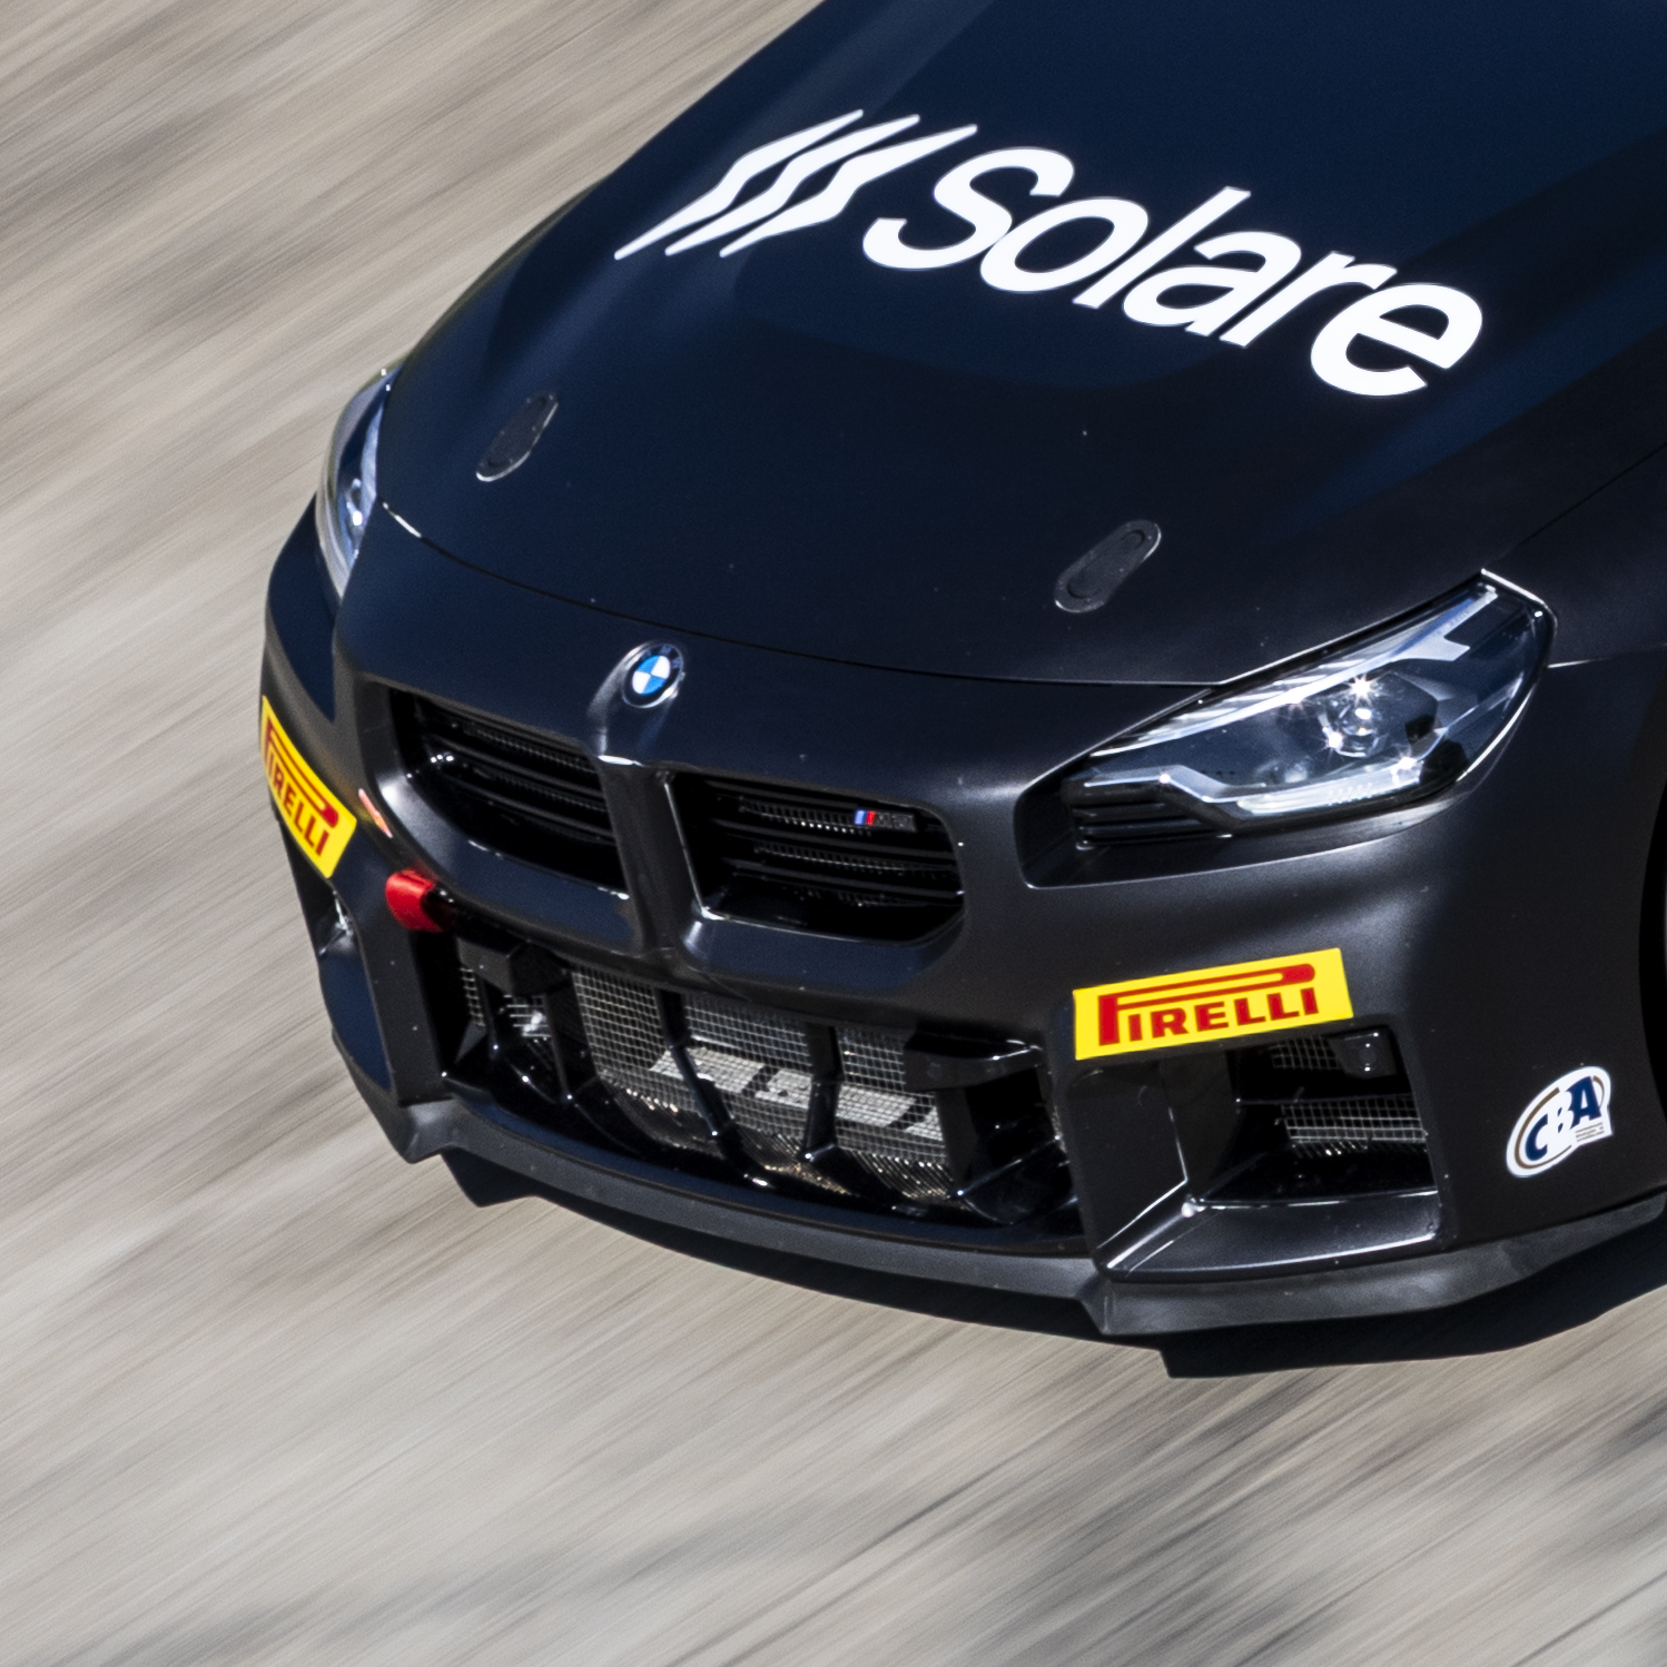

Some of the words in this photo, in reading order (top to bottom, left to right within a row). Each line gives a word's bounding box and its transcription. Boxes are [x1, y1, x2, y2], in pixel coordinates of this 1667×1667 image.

[861, 146, 1484, 397] Solare
[264, 716, 339, 858] PIRELLI
[1097, 962, 1319, 1047] PIRELLI
[1524, 1075, 1603, 1163] CBA
